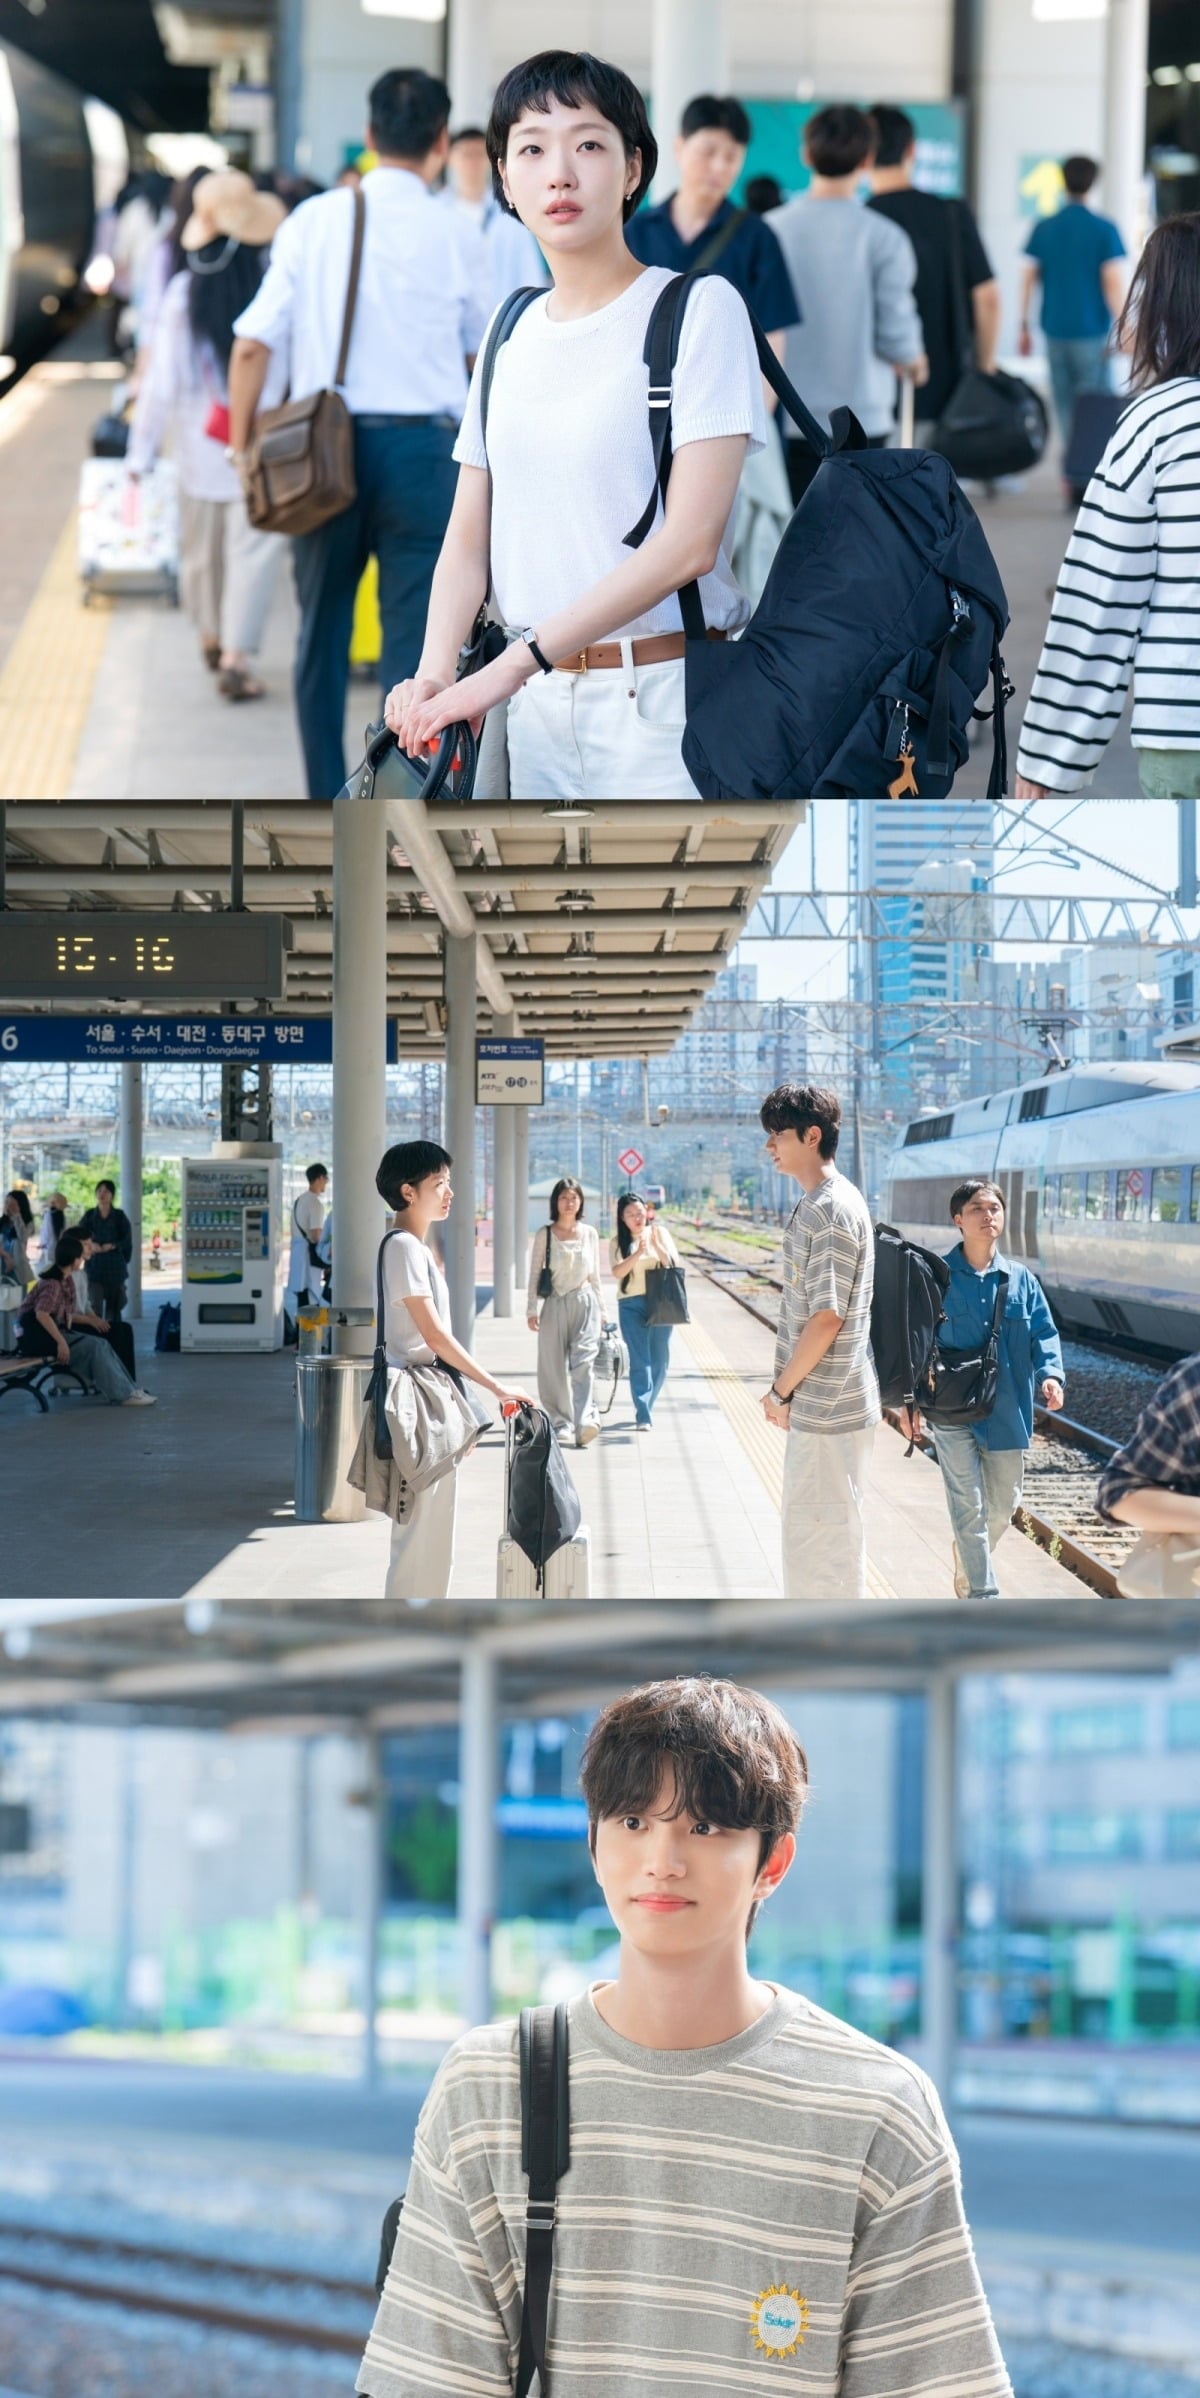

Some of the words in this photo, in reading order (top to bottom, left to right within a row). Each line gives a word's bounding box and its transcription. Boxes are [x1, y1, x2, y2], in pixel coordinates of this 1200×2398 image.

[1, 1026, 18, 1051] 6
[86, 1024, 116, 1042] 서울
[131, 1024, 161, 1042] 수서
[176, 1025, 206, 1043] 대전
[221, 1025, 266, 1043] 동대구
[274, 1025, 304, 1043] 방면
[86, 1044, 97, 1055] To
[99, 1044, 125, 1055] Seoul
[131, 1045, 158, 1055] Suseo
[163, 1045, 201, 1057] Daejeon
[206, 1045, 260, 1057] Dongdaegu
